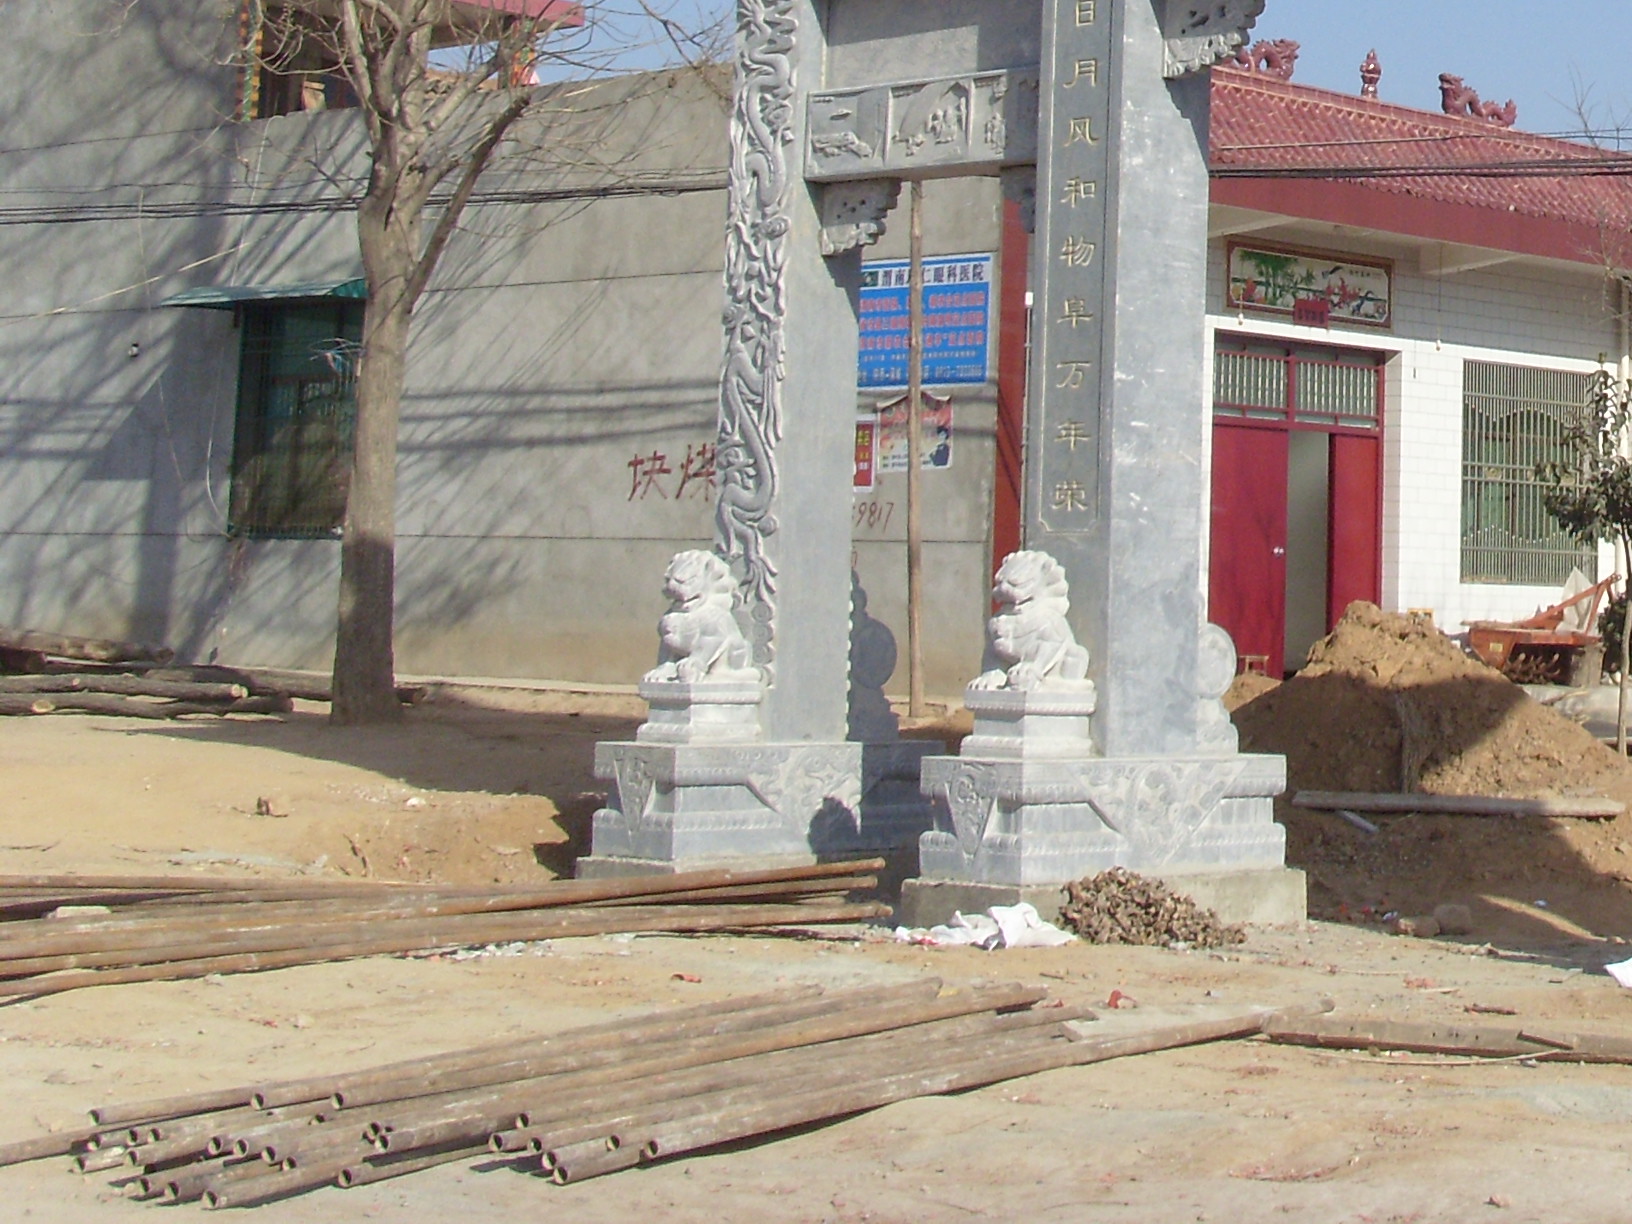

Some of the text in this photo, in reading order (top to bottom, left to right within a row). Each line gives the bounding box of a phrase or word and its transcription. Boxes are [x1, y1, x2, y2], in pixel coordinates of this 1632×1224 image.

[881, 262, 984, 287] 渭南仁眼科医院
